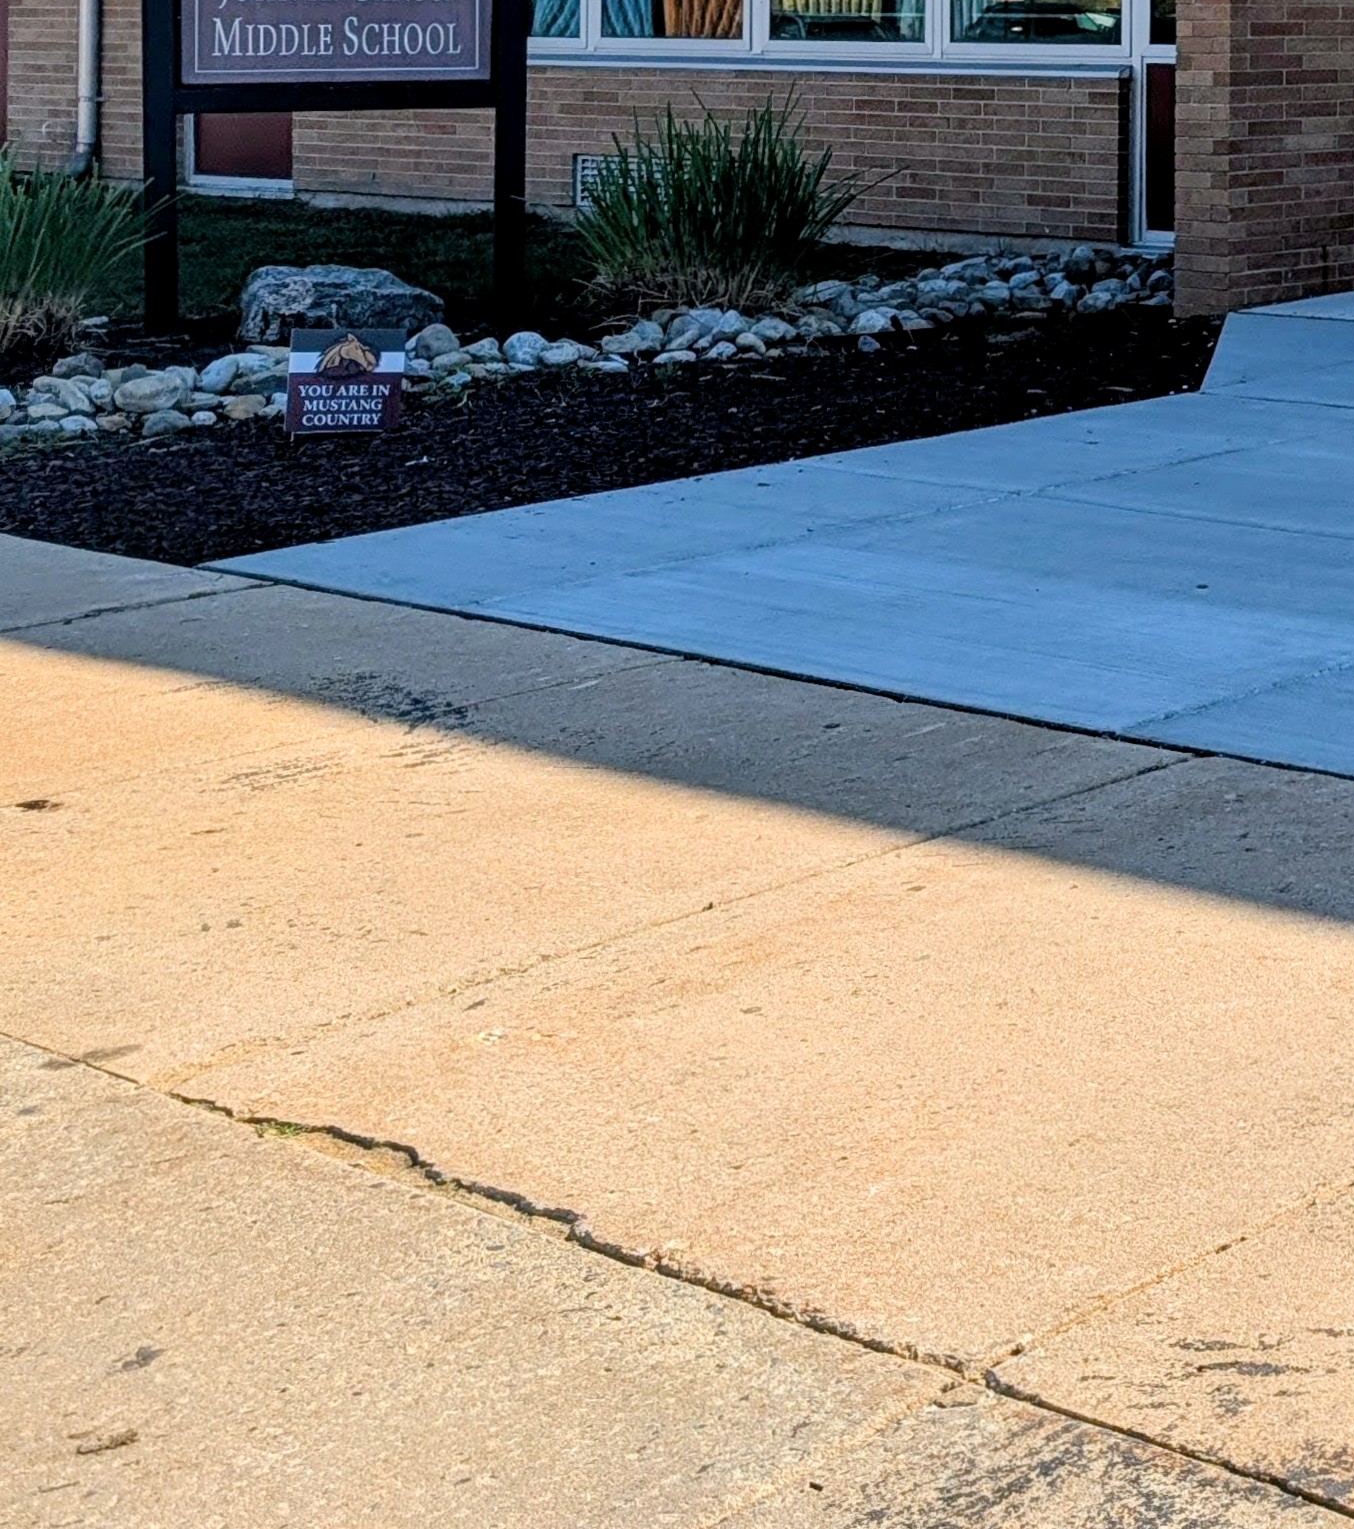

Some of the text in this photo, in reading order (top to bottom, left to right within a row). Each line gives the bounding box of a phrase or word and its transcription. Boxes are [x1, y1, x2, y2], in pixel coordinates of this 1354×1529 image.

[212, 16, 461, 56] MIDDLE SCHOOL
[298, 384, 390, 397] YOU ARE IN
[302, 398, 383, 412] MUSTANG
[302, 413, 382, 426] COUNTRY
